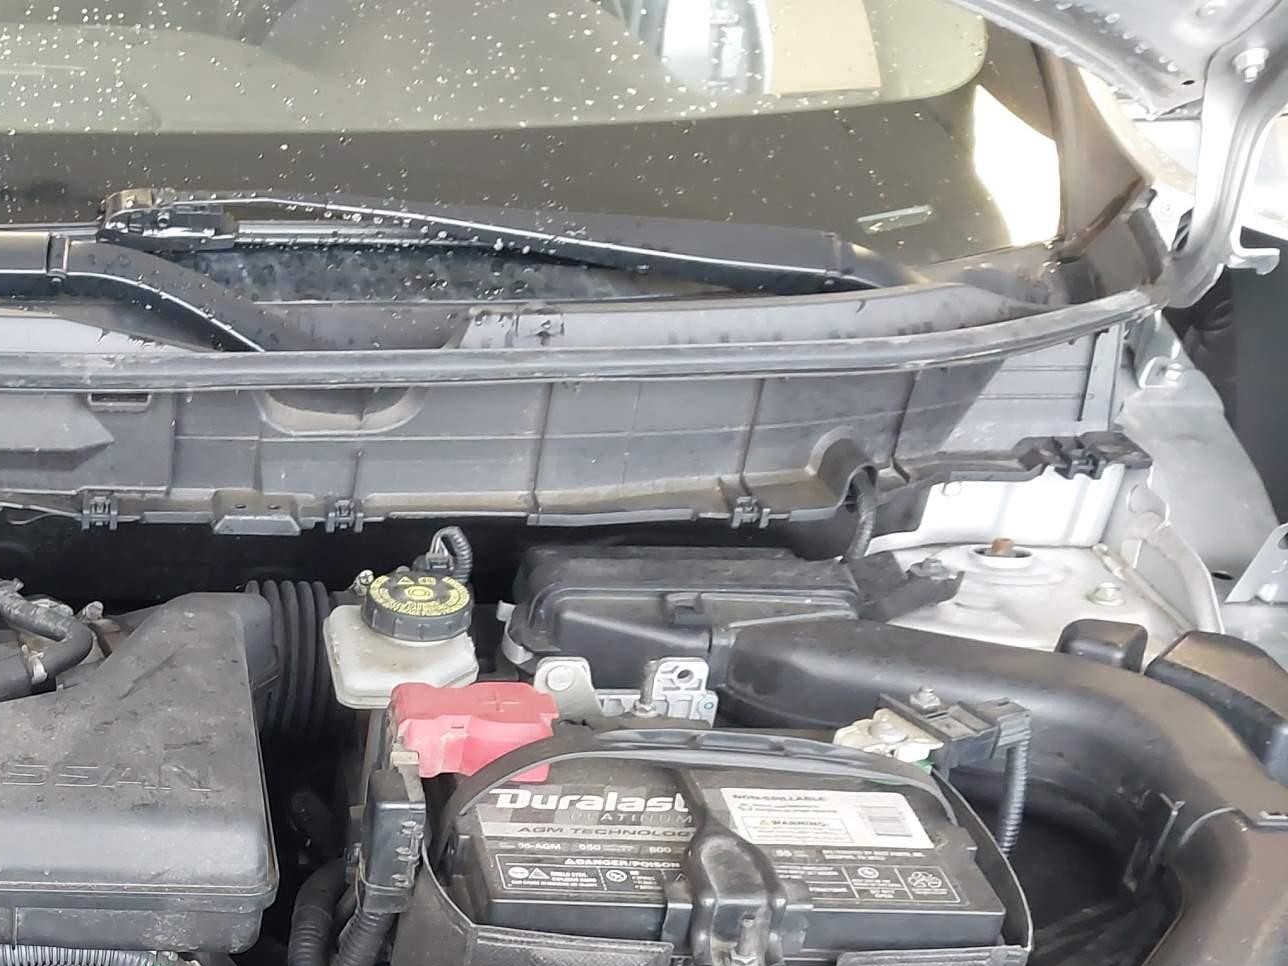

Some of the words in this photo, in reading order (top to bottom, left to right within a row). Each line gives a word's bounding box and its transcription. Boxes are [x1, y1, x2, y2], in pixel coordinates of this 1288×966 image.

[489, 788, 690, 813] Duralast
[517, 826, 564, 834] AGM
[570, 826, 696, 837] TECHNOLOG
